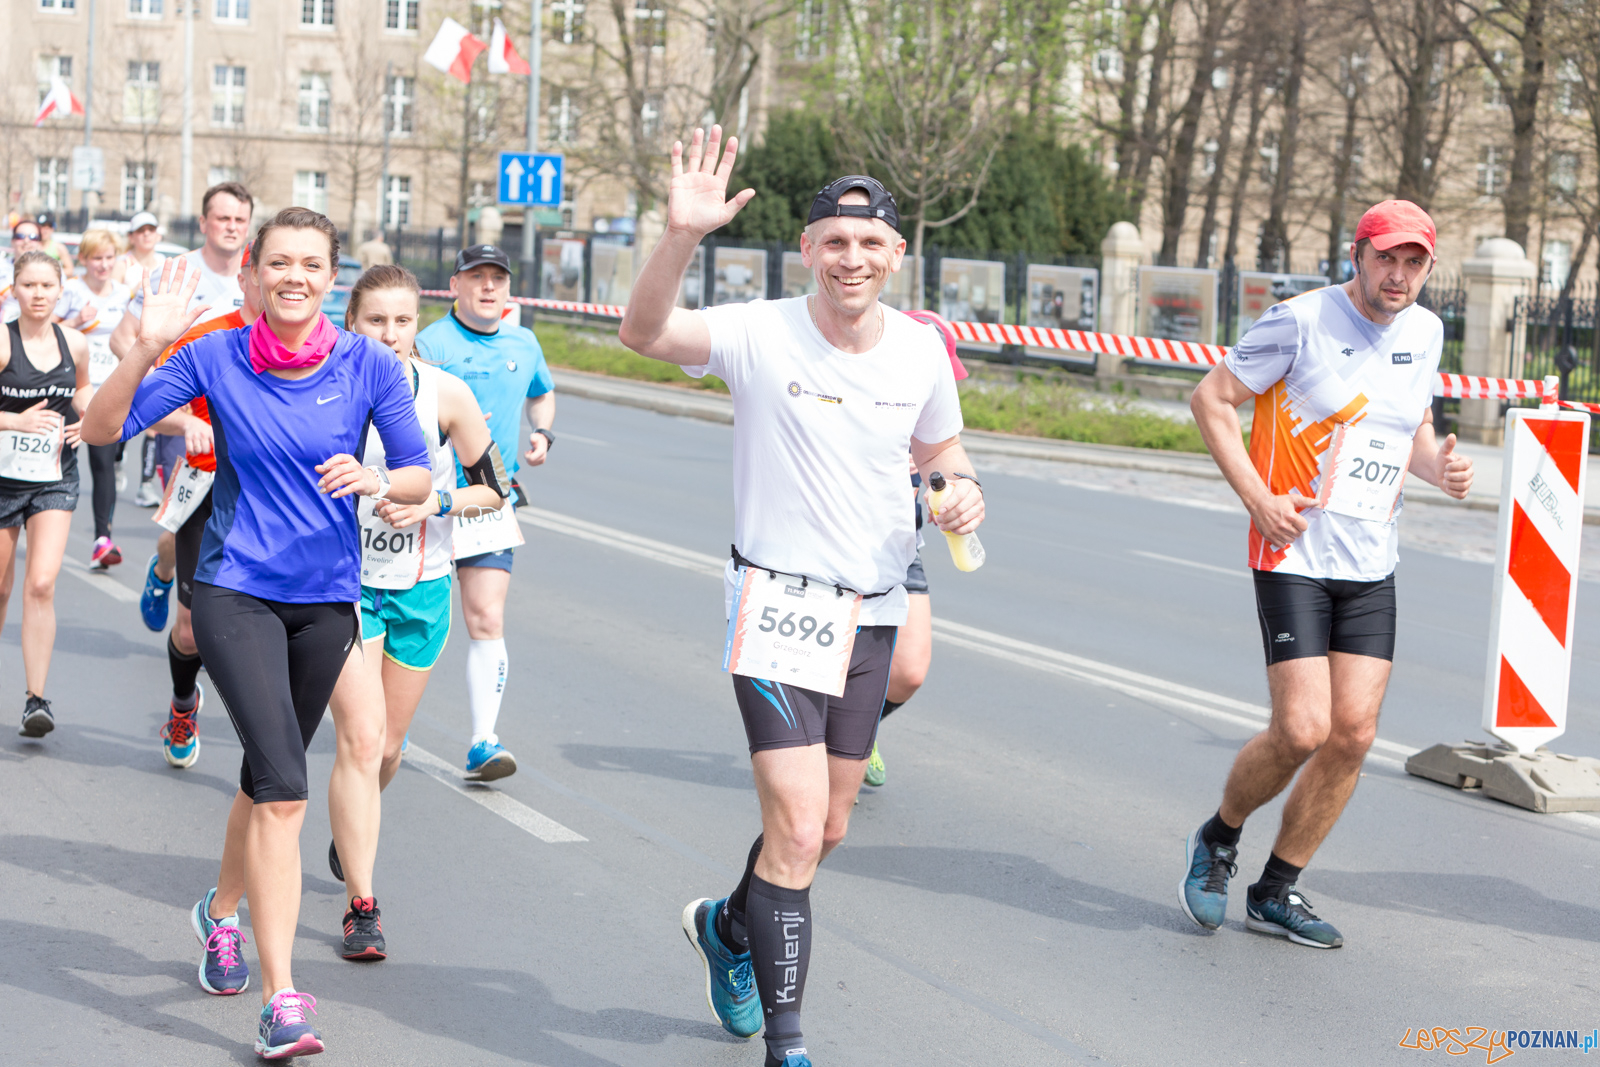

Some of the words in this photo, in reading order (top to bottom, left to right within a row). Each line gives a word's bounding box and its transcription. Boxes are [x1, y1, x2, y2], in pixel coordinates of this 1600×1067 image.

[1, 385, 47, 398] HANSA
[11, 435, 51, 453] 1526
[1348, 457, 1401, 487] 2077
[758, 606, 835, 648] 5696
[773, 641, 812, 658] Grzegorz
